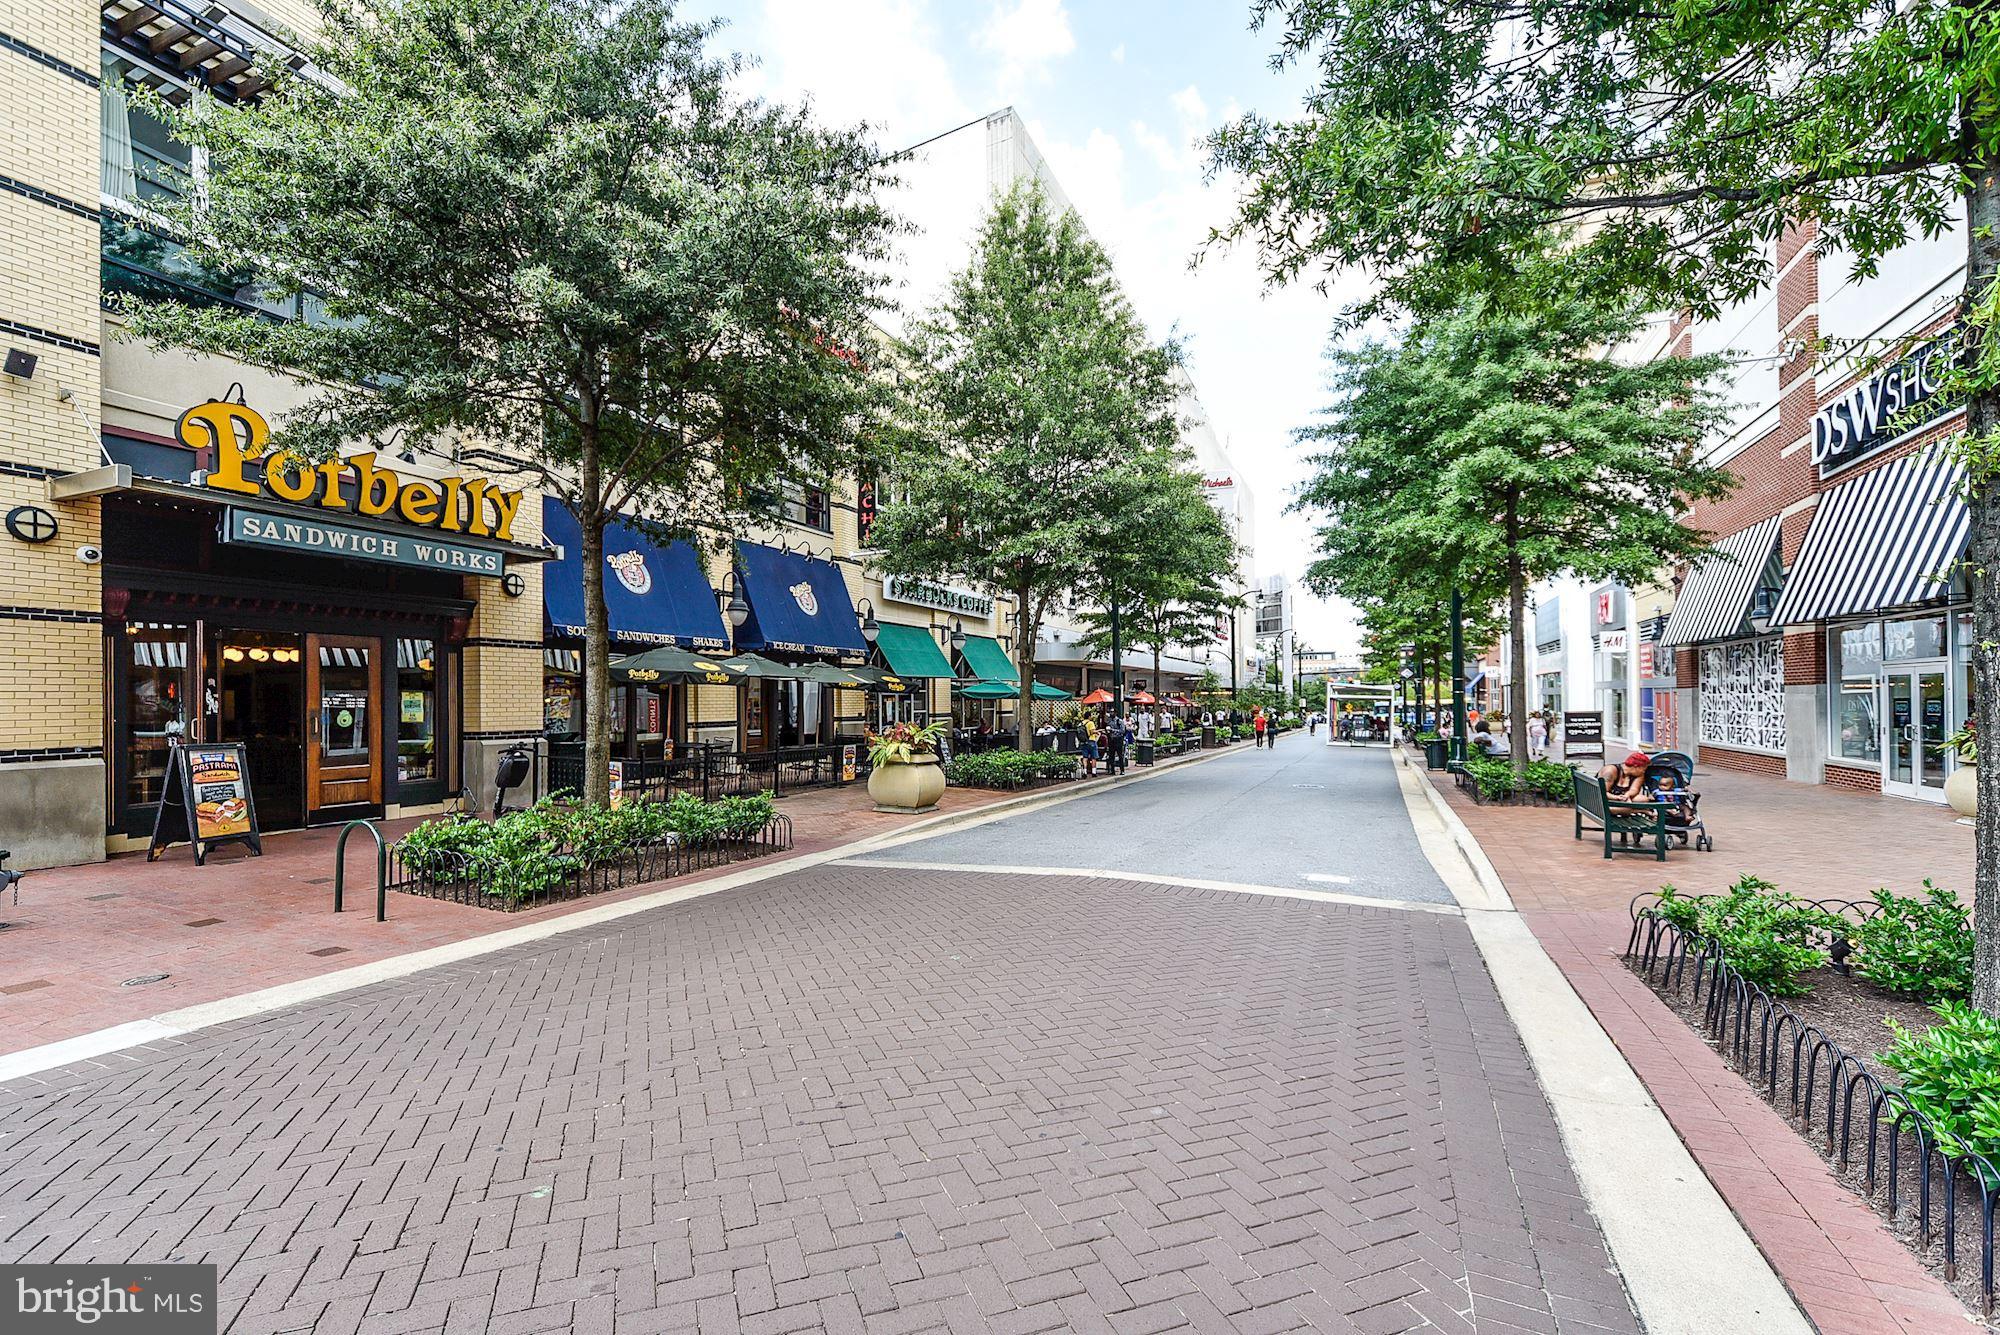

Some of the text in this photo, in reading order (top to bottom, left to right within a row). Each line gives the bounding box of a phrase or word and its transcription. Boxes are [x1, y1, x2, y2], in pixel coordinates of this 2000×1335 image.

[1809, 374, 1886, 466] DSW
[179, 402, 523, 541] Potbelly
[243, 517, 497, 572] SANDWICH WORKS
[895, 579, 993, 614] SRBUCKS COFFEE
[617, 630, 676, 645] SANDWICHES
[692, 636, 723, 648] SHAKES
[773, 641, 785, 649] ICE
[784, 642, 805, 652] CREAM
[813, 645, 838, 655] COOKIES
[628, 668, 659, 681] Potbelly
[706, 672, 730, 684] Potbelly
[192, 762, 237, 773] PASTRAMI
